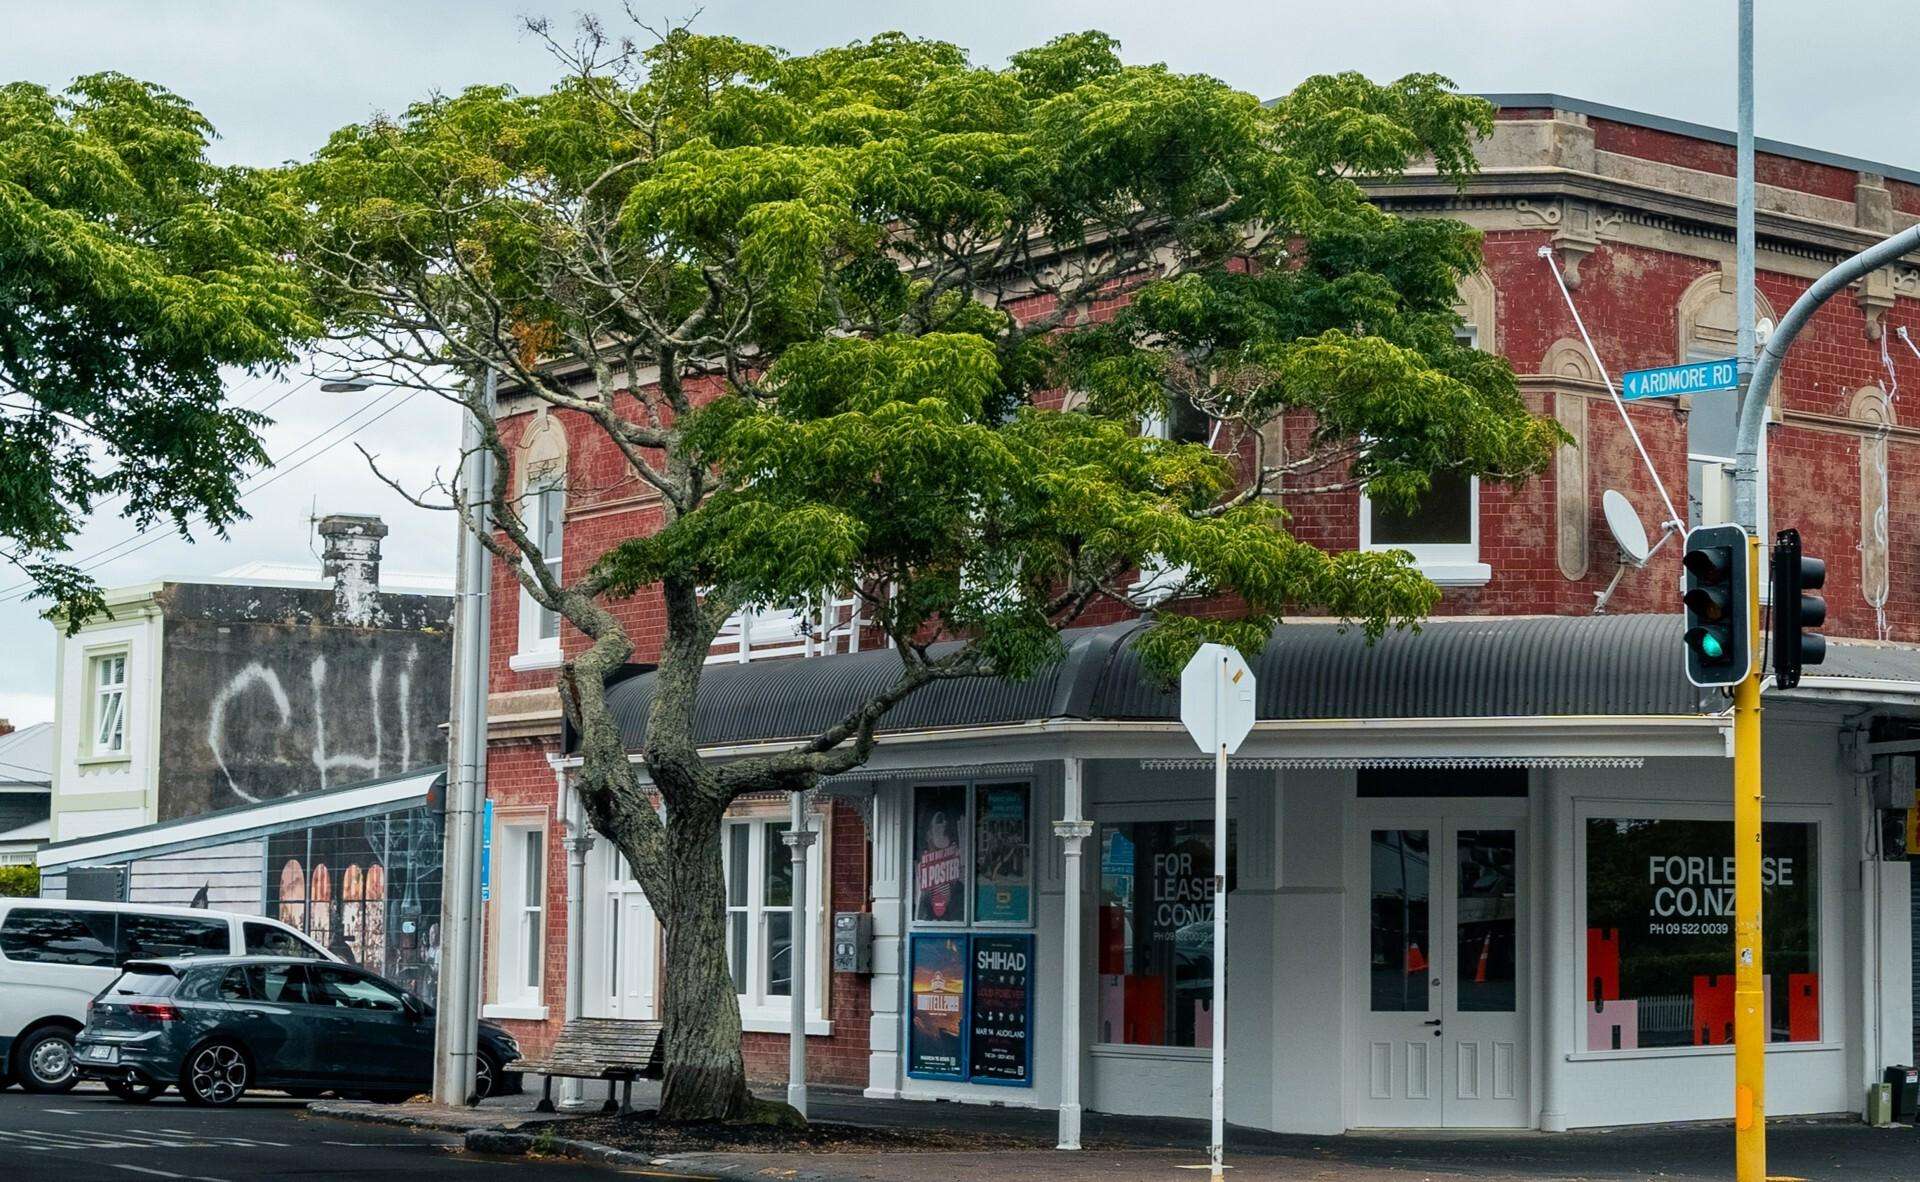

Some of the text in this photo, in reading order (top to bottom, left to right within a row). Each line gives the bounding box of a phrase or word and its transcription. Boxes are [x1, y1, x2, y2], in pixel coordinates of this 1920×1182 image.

[1640, 364, 1732, 394] ARDMORE RD
[929, 858, 959, 887] POSTER
[1154, 853, 1192, 876] FOR
[1649, 856, 1794, 886] FORLESE
[1154, 878, 1215, 902] LEASE
[1649, 887, 1737, 917] .CO.NZ
[1649, 922, 1729, 935] PH 09 522 0039
[977, 951, 1026, 971] SHIHAD
